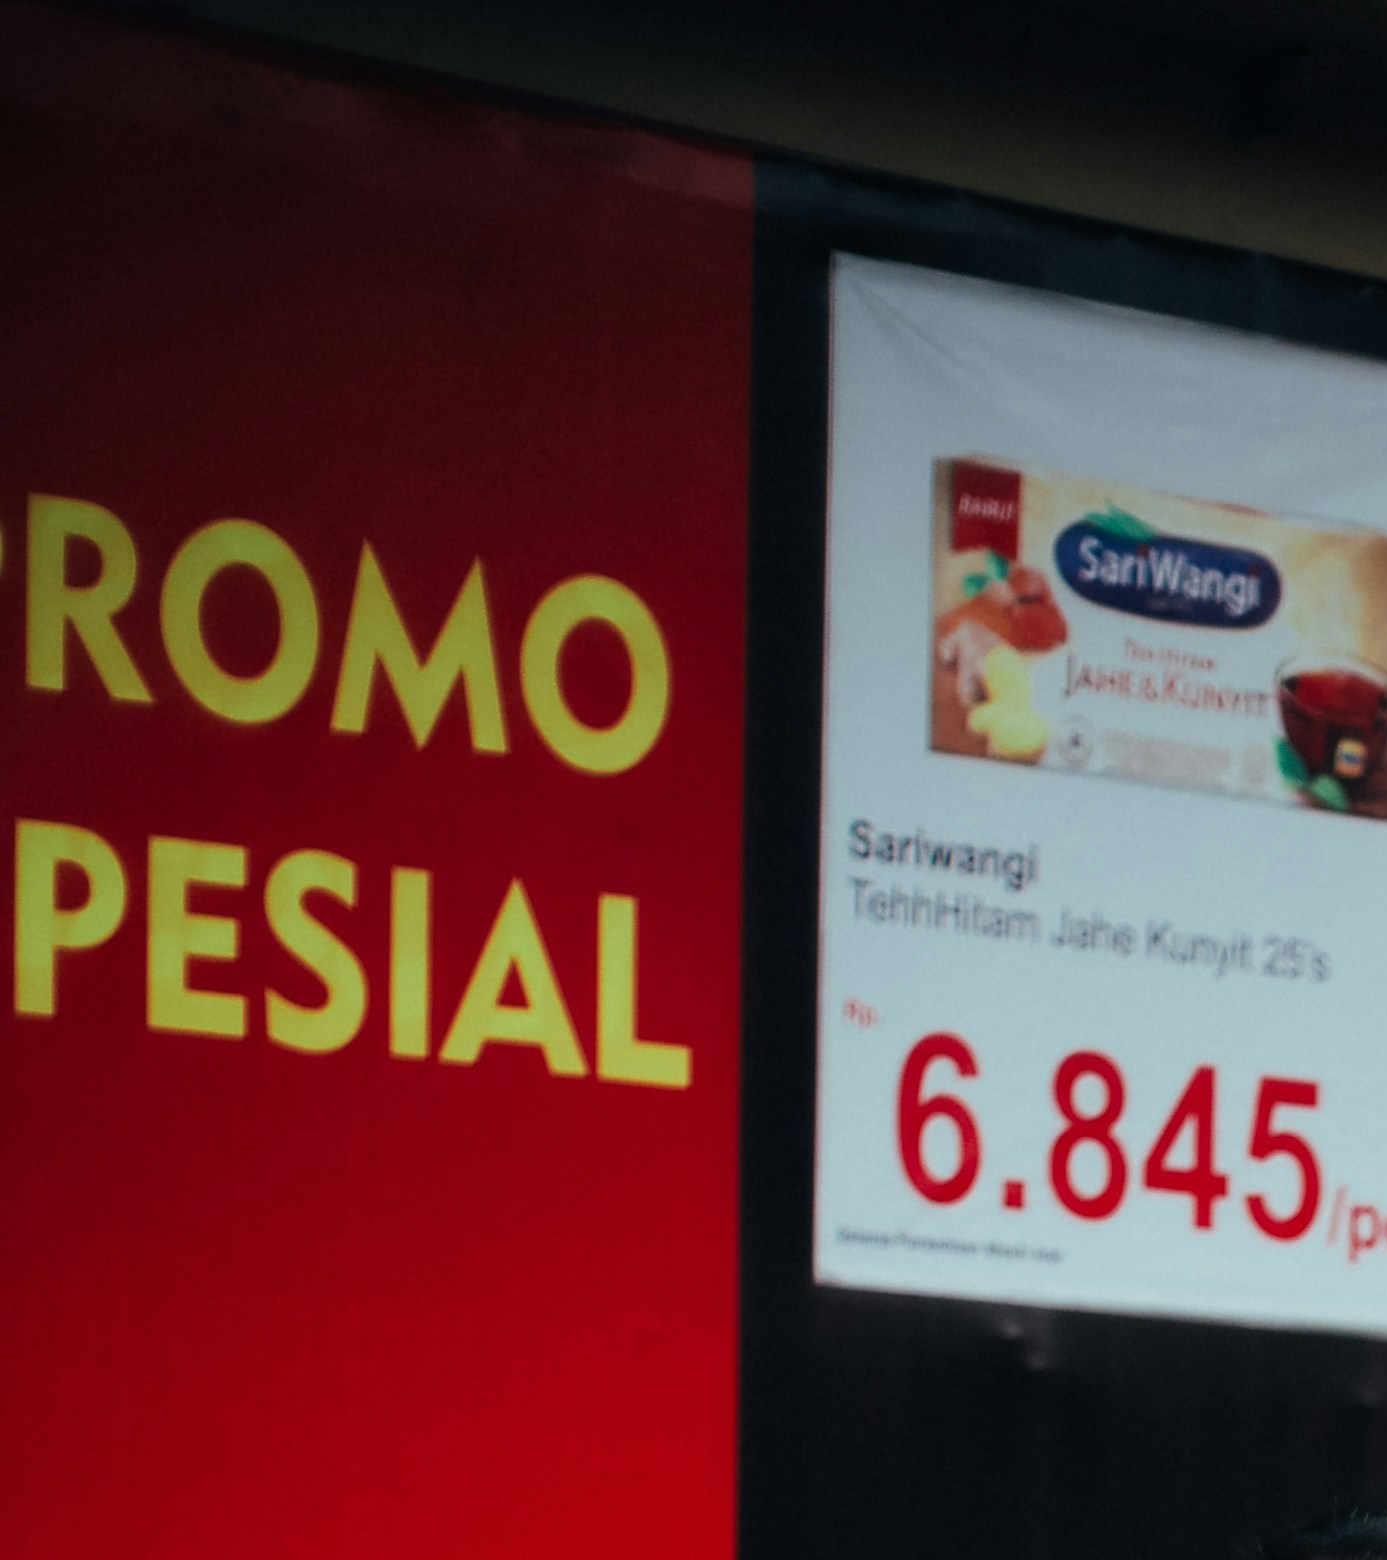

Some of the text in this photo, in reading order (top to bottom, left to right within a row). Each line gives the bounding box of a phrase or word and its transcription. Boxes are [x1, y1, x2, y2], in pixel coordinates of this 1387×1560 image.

[1077, 536, 1262, 616] SariWangi
[0, 490, 672, 777] ROMO
[848, 818, 1040, 890] Sariwangi
[1050, 908, 1137, 957] Jahe
[1145, 918, 1255, 980] Kunyit
